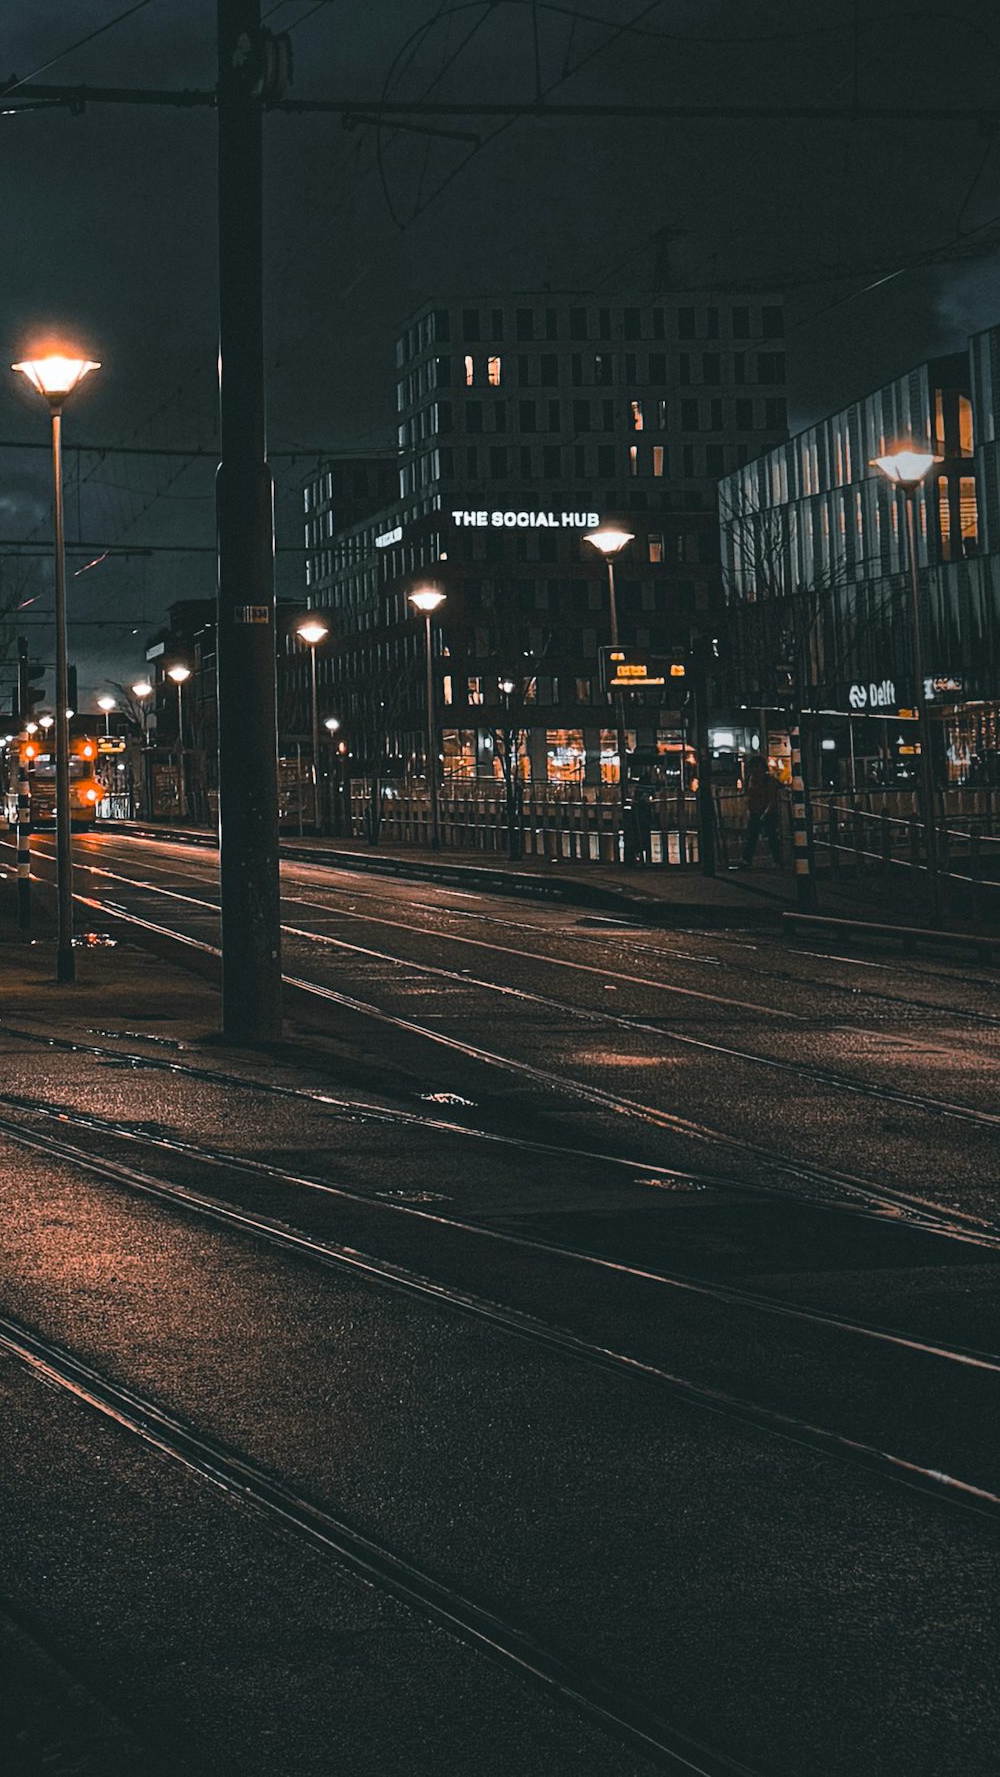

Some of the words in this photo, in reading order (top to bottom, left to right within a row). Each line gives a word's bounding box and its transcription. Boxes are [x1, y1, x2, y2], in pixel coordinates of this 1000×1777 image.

[452, 511, 488, 527] THE
[491, 512, 559, 527] SOCIAL
[561, 513, 600, 527] HUB
[869, 679, 896, 707] Delft
